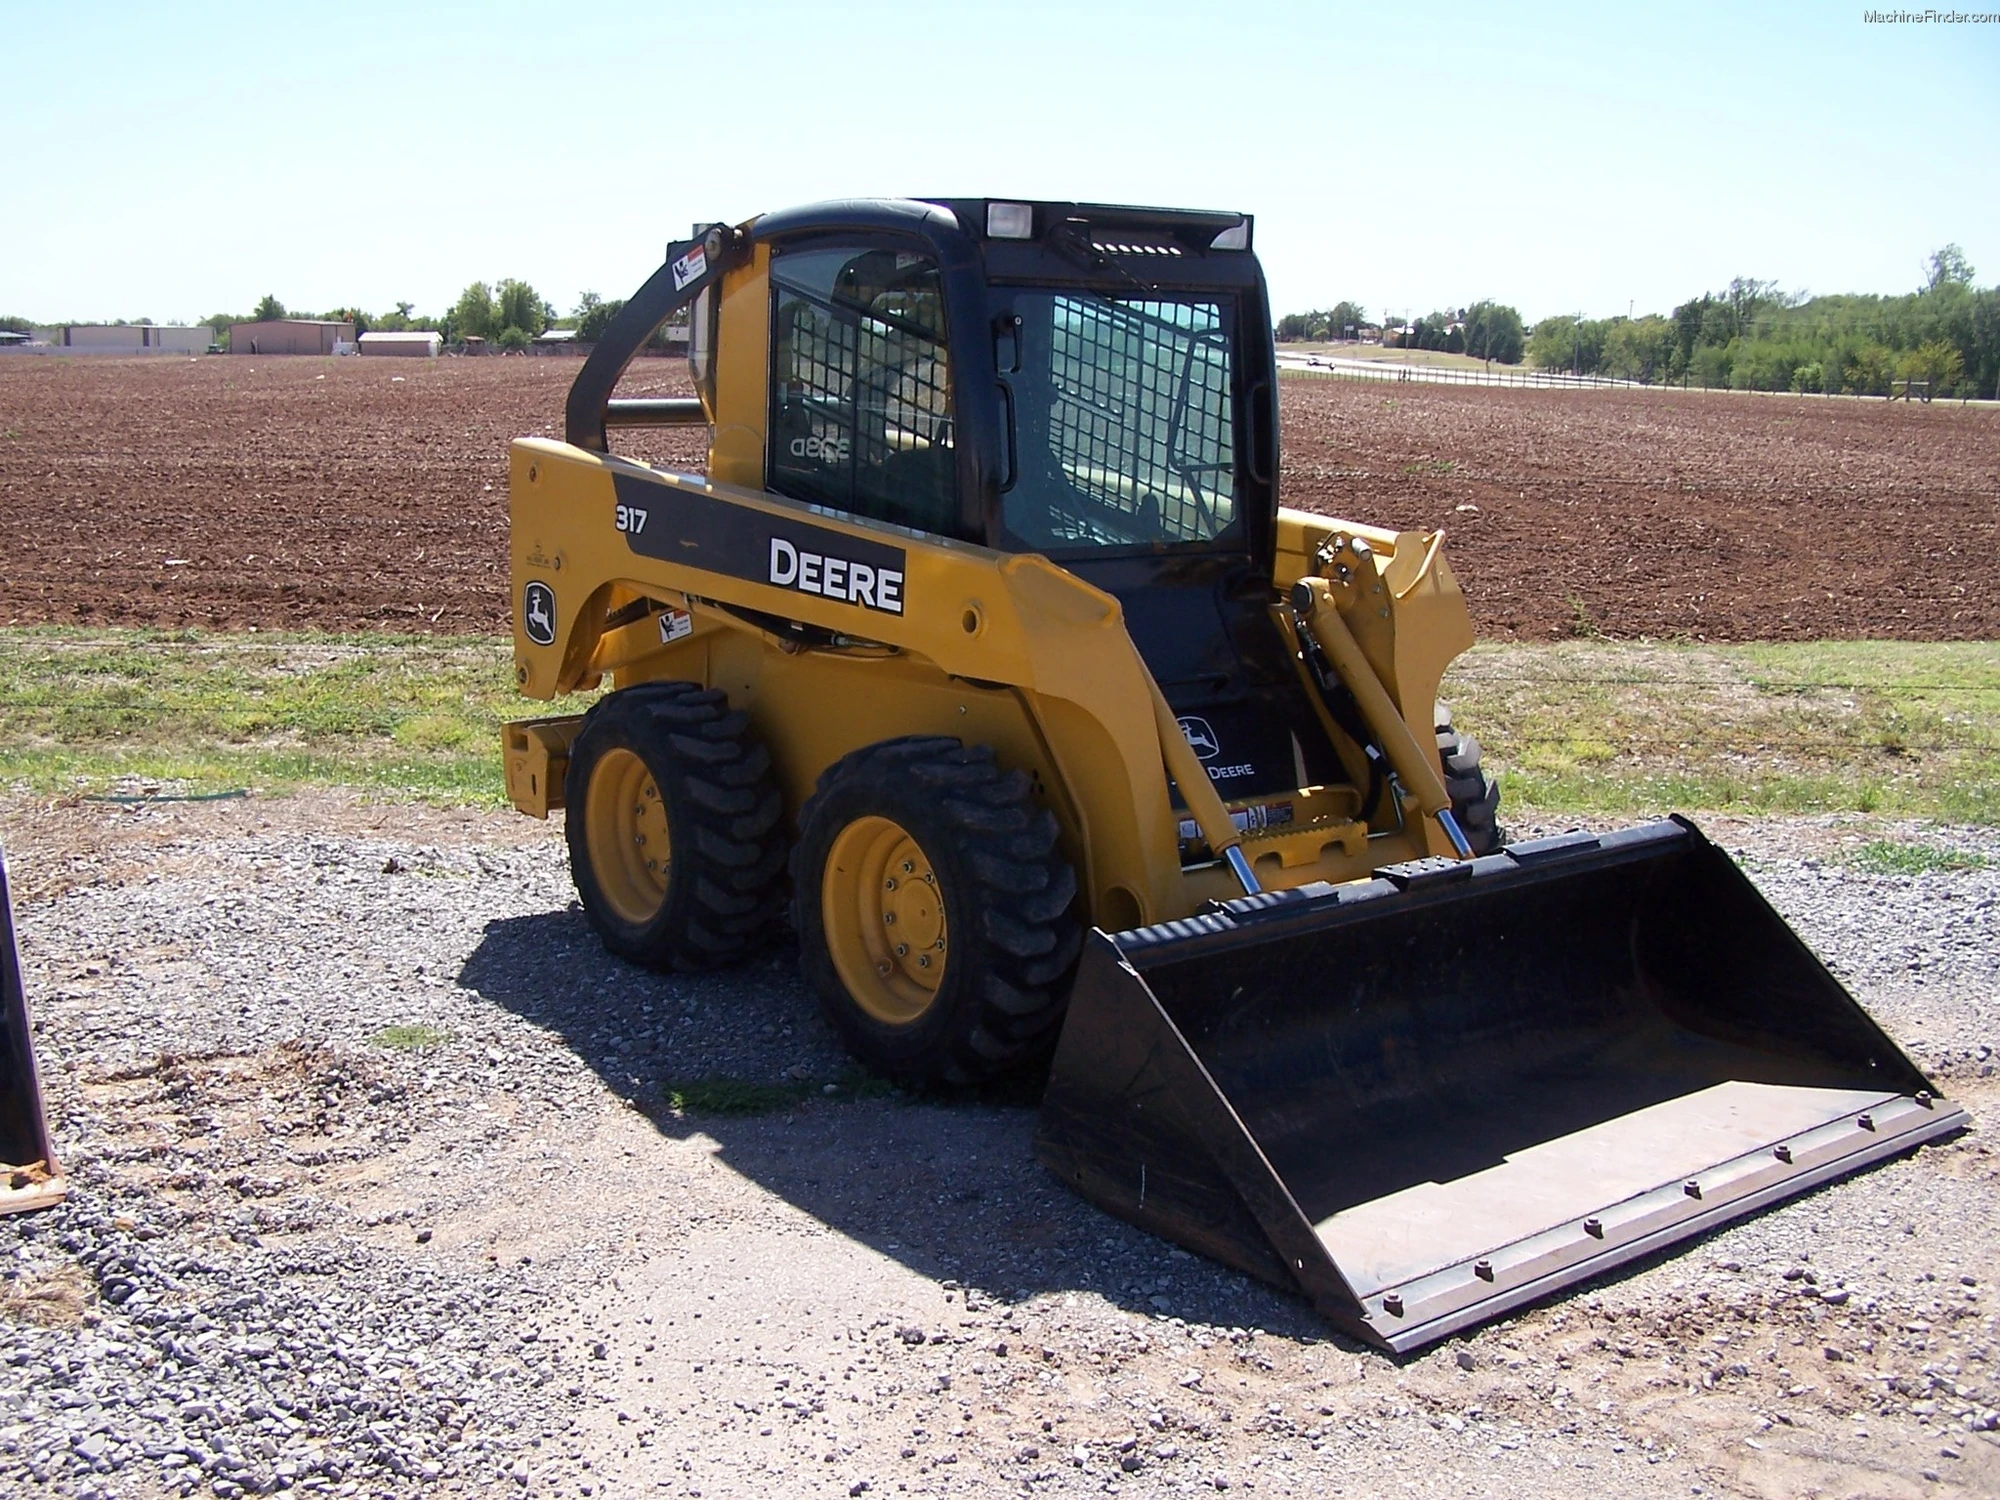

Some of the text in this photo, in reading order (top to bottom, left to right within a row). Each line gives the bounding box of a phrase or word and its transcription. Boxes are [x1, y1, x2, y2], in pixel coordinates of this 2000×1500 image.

[616, 504, 648, 534] 317
[769, 537, 903, 613] DEERE
[1207, 763, 1255, 780] DEERE
